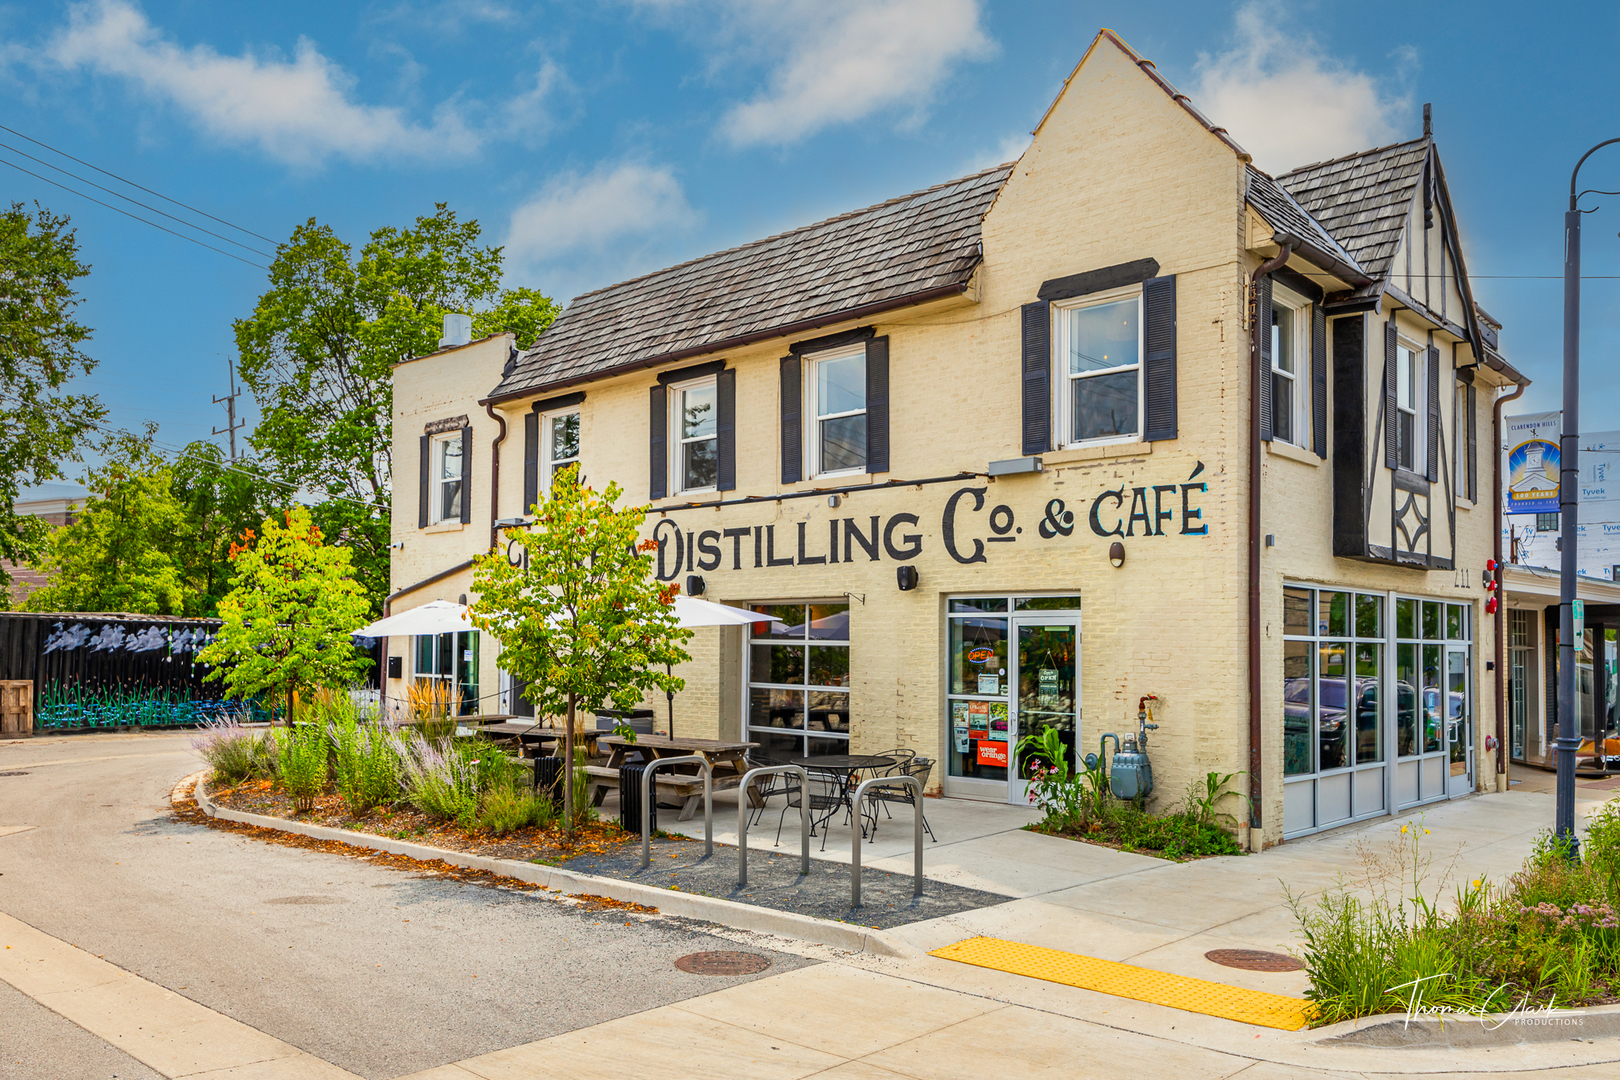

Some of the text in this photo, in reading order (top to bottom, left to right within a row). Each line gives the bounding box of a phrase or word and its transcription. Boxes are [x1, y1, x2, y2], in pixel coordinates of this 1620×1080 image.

[1511, 422, 1540, 431] CLARENDON
[1582, 488, 1606, 496] Tyvek
[652, 513, 923, 581] DISTILLING
[1038, 499, 1075, 539] &
[1089, 460, 1208, 539] CAFÉ
[1603, 524, 1620, 532] Tyve
[968, 650, 994, 661] OPEN
[981, 751, 1006, 761] orange
